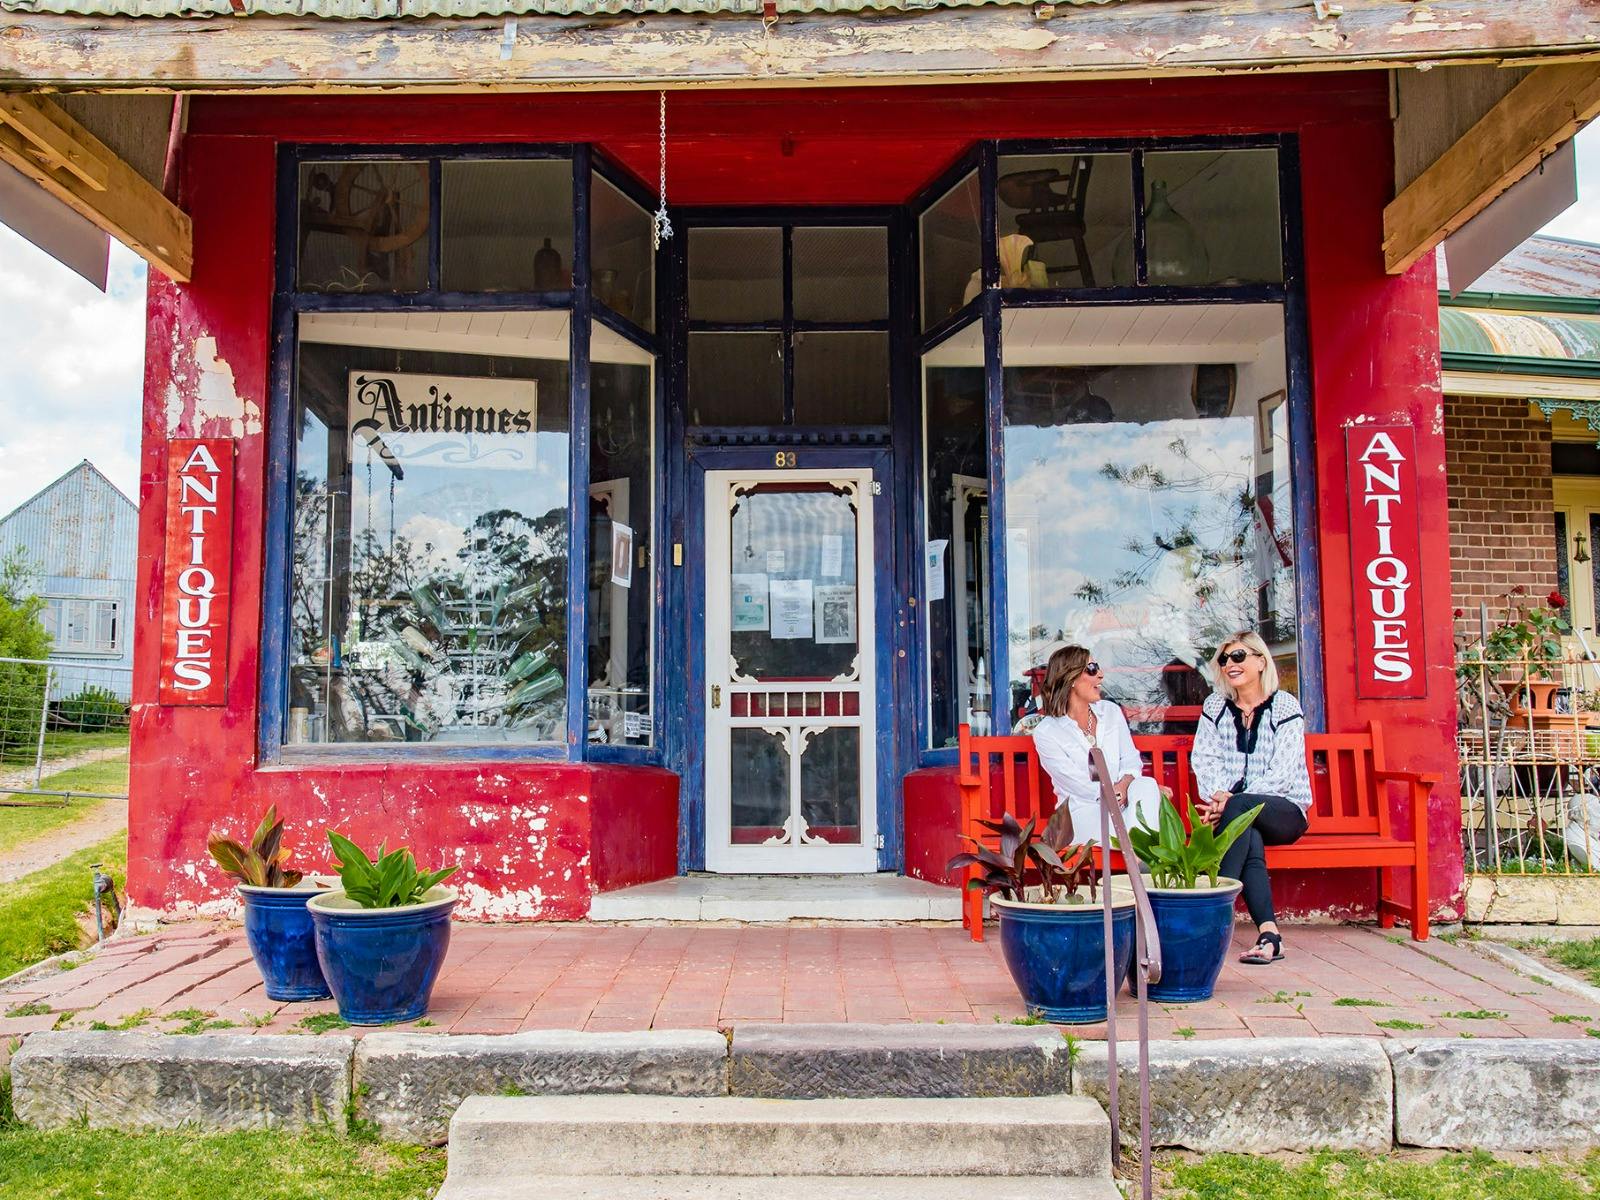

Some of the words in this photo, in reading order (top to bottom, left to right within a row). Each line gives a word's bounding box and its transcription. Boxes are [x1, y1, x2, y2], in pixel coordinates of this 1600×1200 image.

[352, 375, 532, 450] Antiques
[775, 451, 797, 468] 83
[173, 444, 221, 691] ANTIQUES
[1358, 431, 1413, 683] ANTIQUES
